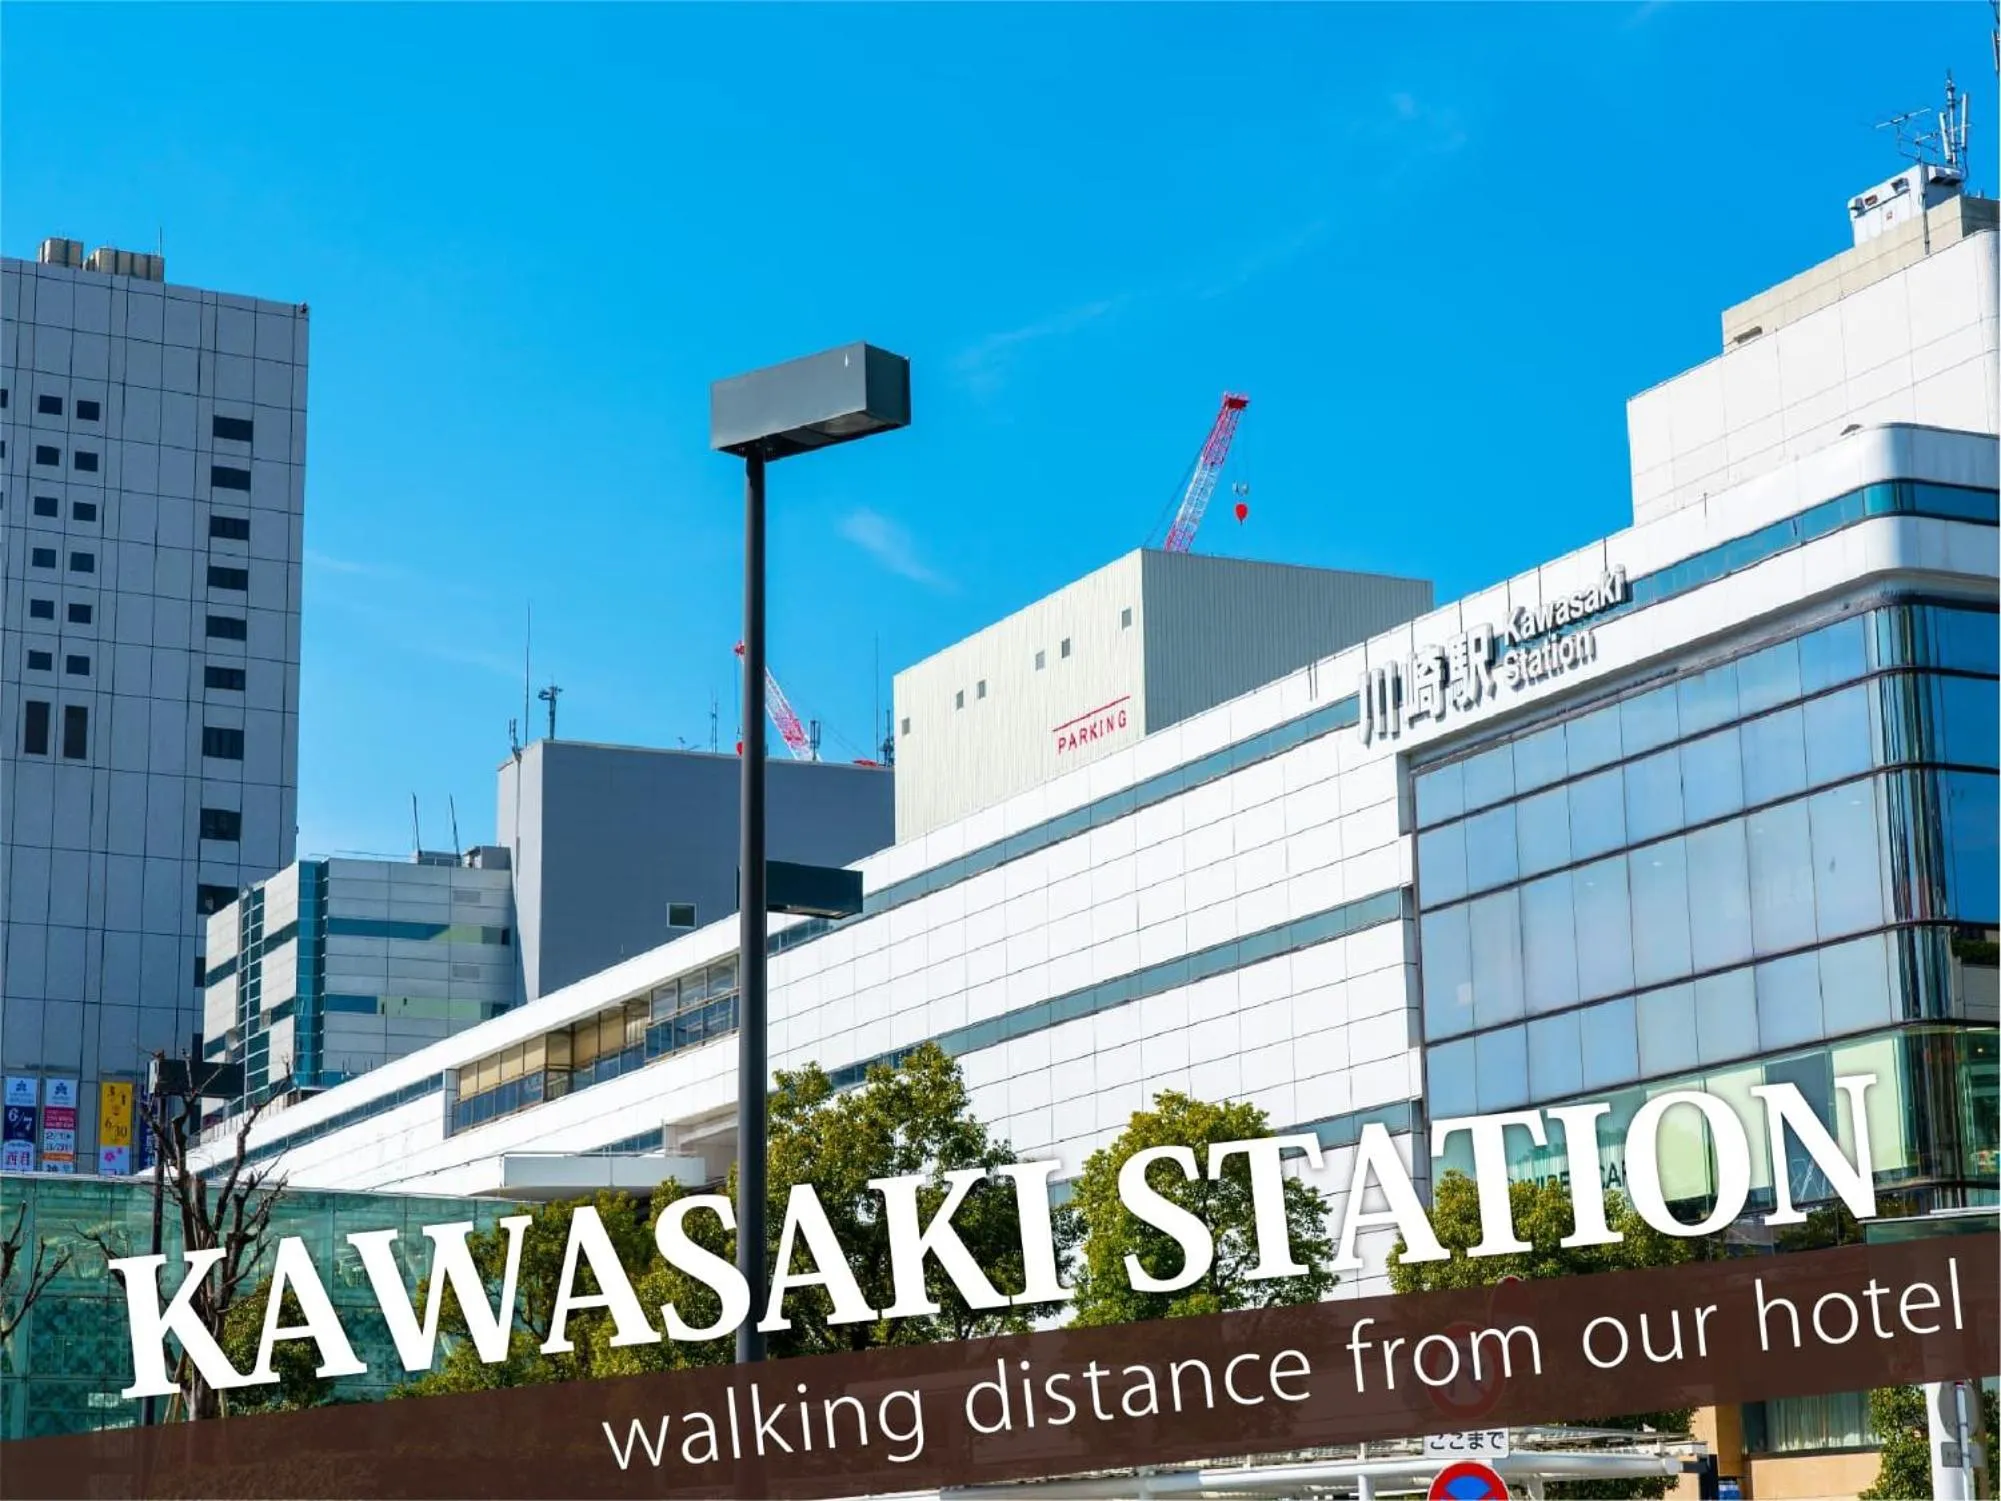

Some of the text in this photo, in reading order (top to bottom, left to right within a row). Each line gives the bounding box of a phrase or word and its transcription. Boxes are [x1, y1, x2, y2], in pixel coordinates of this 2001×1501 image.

[1503, 564, 1628, 647] Kawasaki
[1358, 623, 1496, 746] 川崎駅
[1503, 630, 1597, 690] Station
[1058, 709, 1127, 755] PARKING
[1430, 1431, 1504, 1450] ここまで
